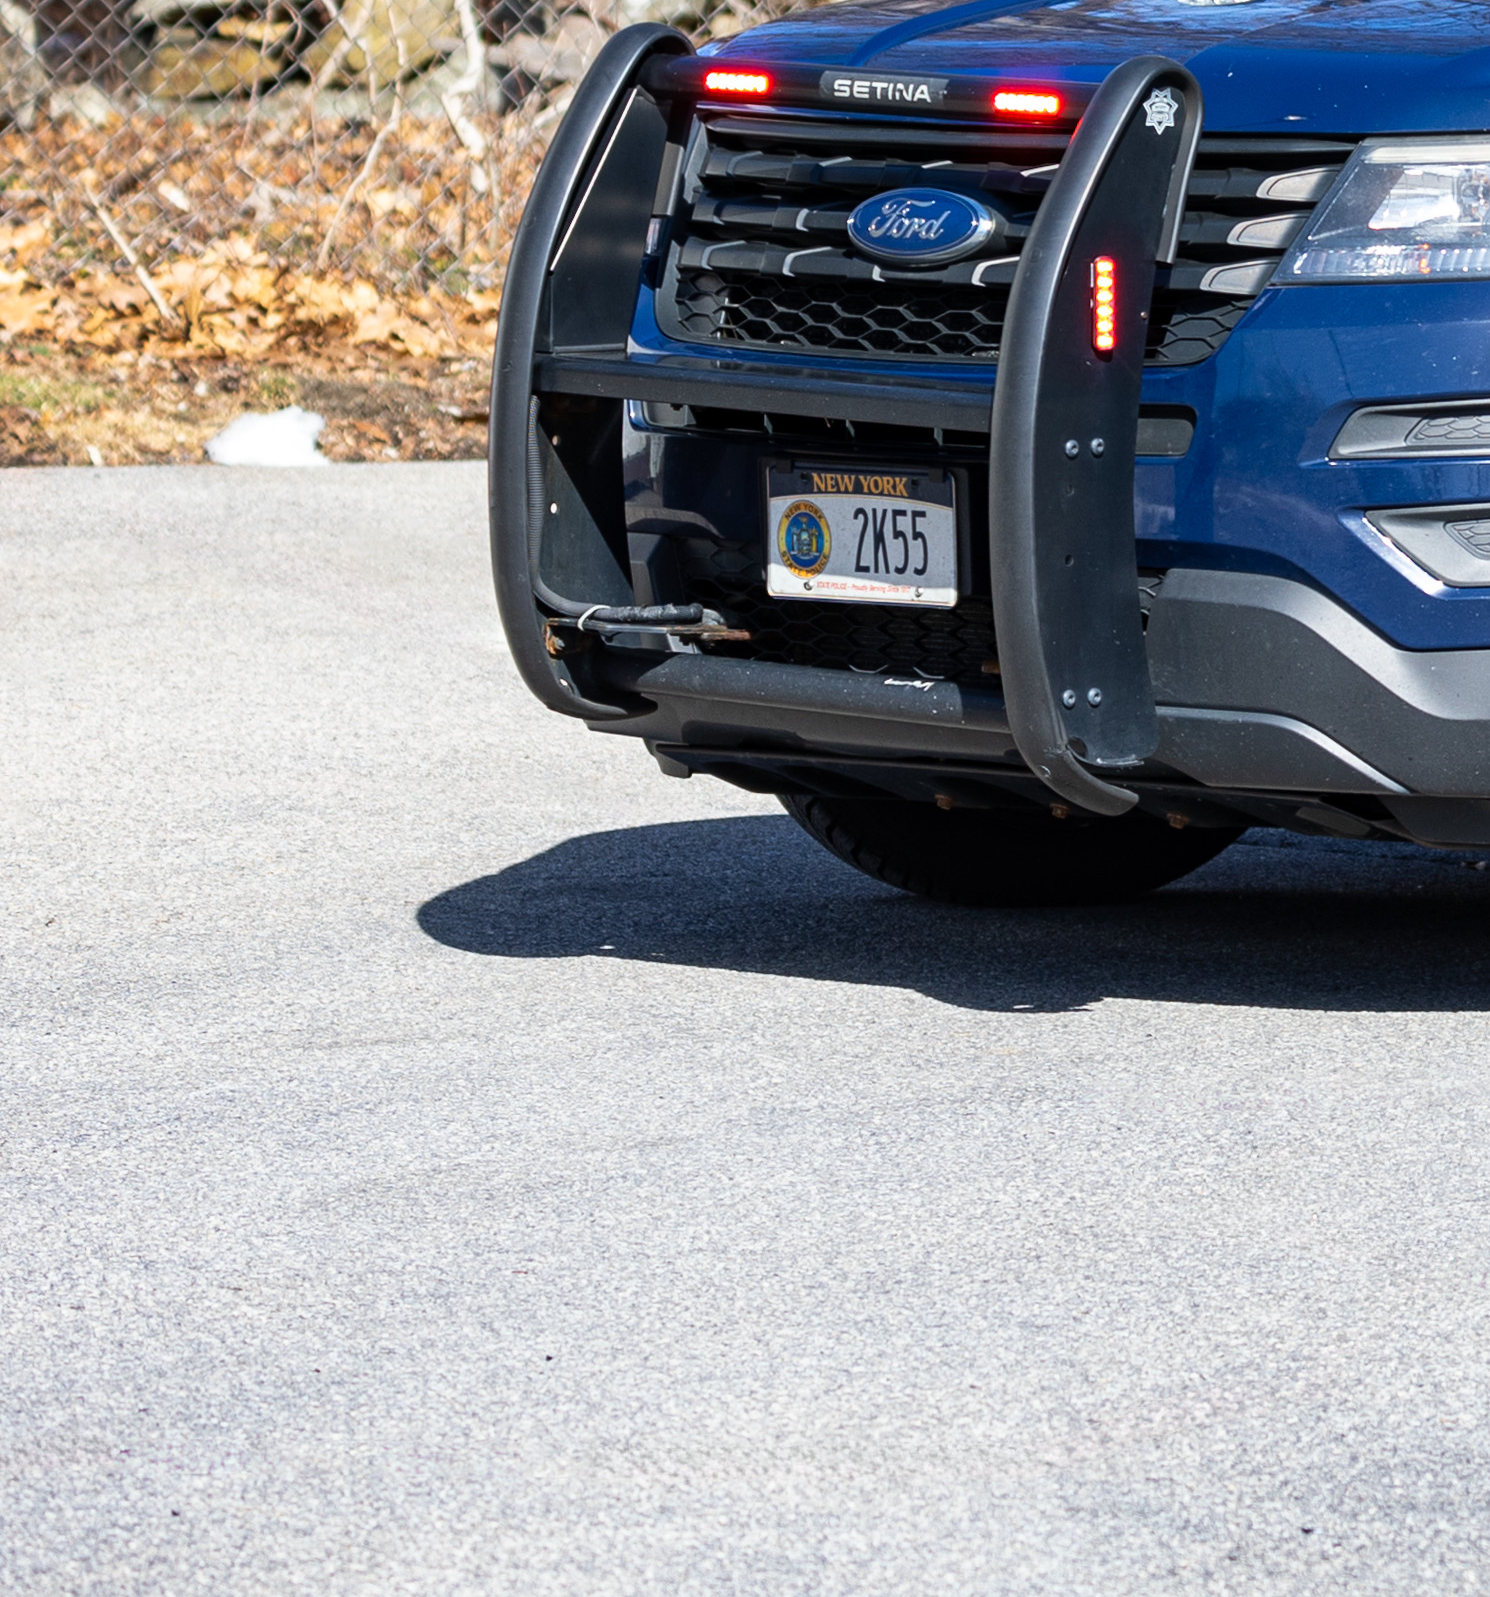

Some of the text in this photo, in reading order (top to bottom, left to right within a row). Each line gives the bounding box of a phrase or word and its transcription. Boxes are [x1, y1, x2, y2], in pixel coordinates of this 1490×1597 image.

[833, 79, 931, 103] SETINA
[868, 197, 951, 240] Ford
[811, 473, 909, 497] NEW YORK
[853, 507, 928, 576] 2K55
